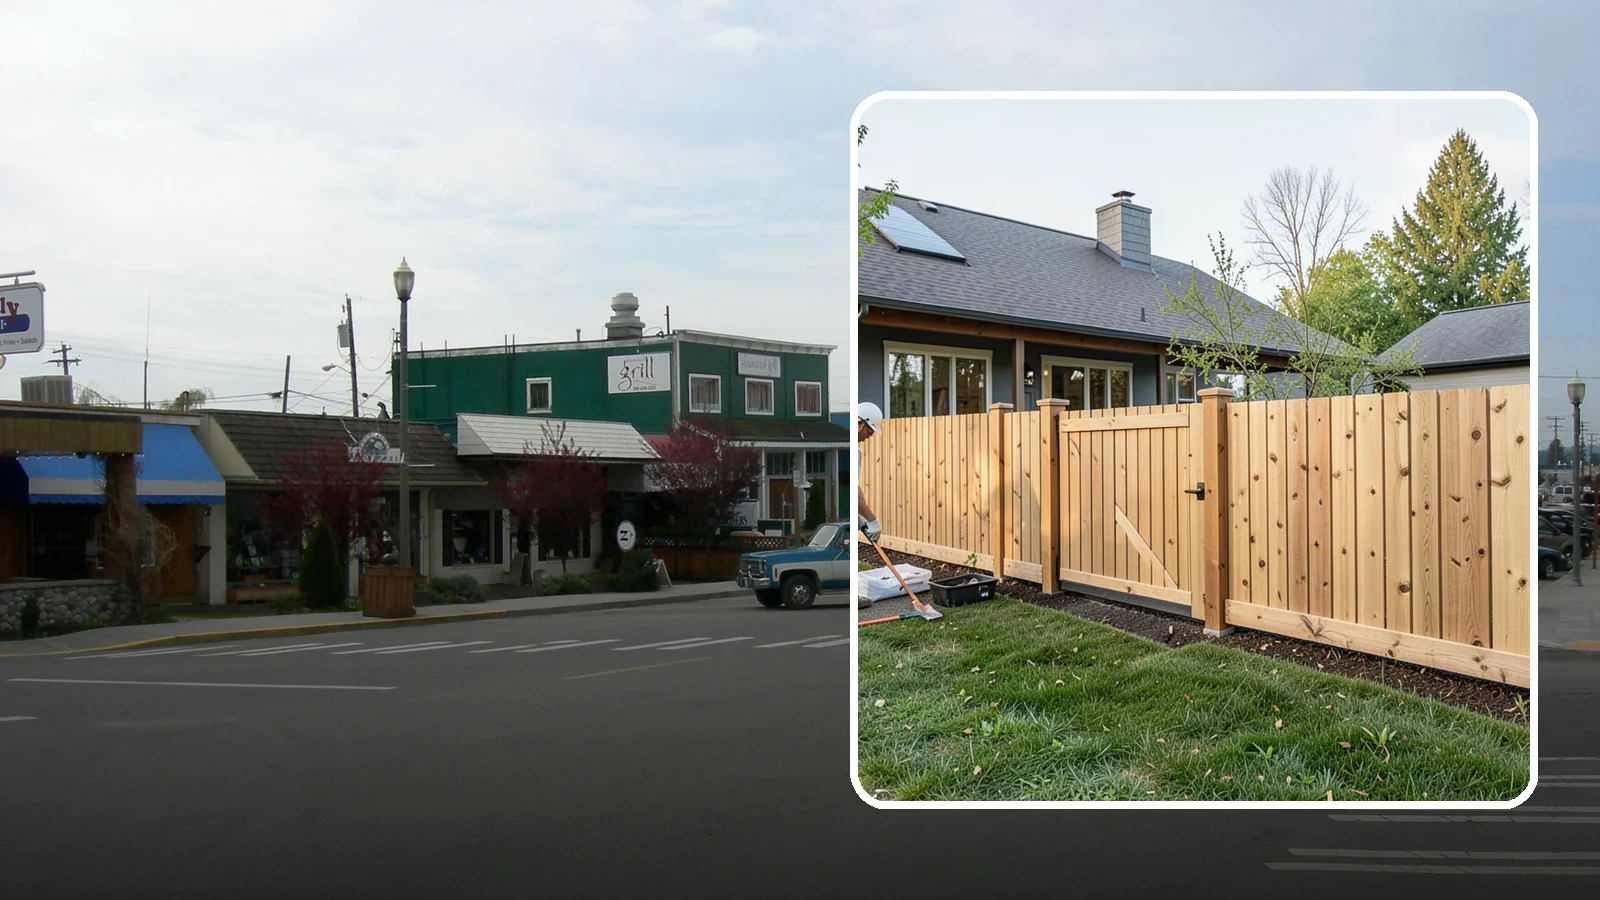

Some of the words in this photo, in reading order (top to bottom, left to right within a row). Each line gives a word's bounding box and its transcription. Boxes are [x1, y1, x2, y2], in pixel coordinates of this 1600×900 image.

[20, 337, 38, 345] Salads
[618, 355, 655, 391] grill
[619, 530, 634, 542] Z's
